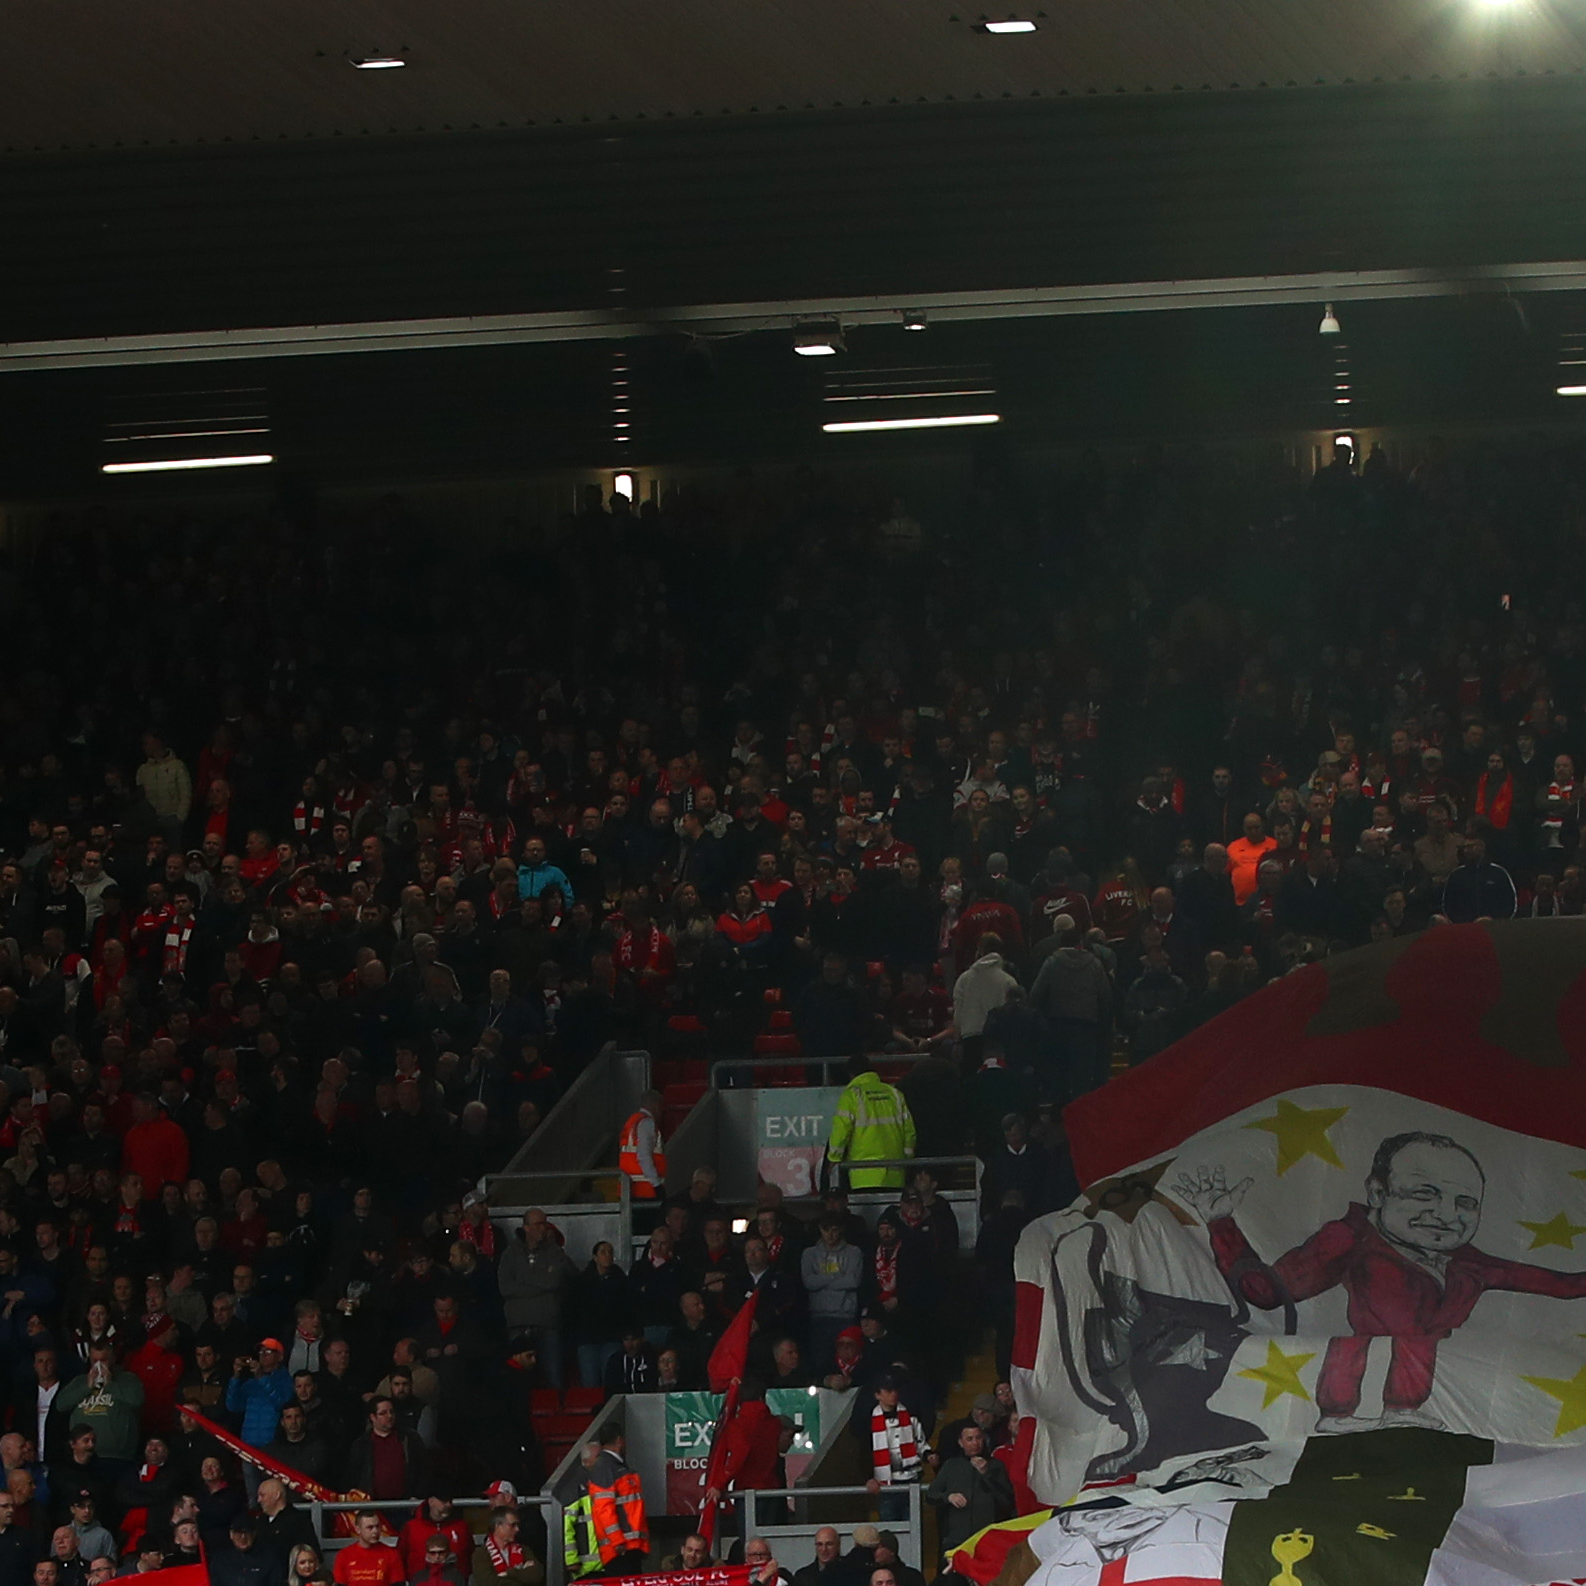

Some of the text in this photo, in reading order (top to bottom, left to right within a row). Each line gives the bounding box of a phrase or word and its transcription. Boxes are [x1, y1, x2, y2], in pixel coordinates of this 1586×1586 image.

[765, 1115, 824, 1139] EXIT
[674, 1426, 715, 1448] EX
[674, 1458, 708, 1471] BLOC
